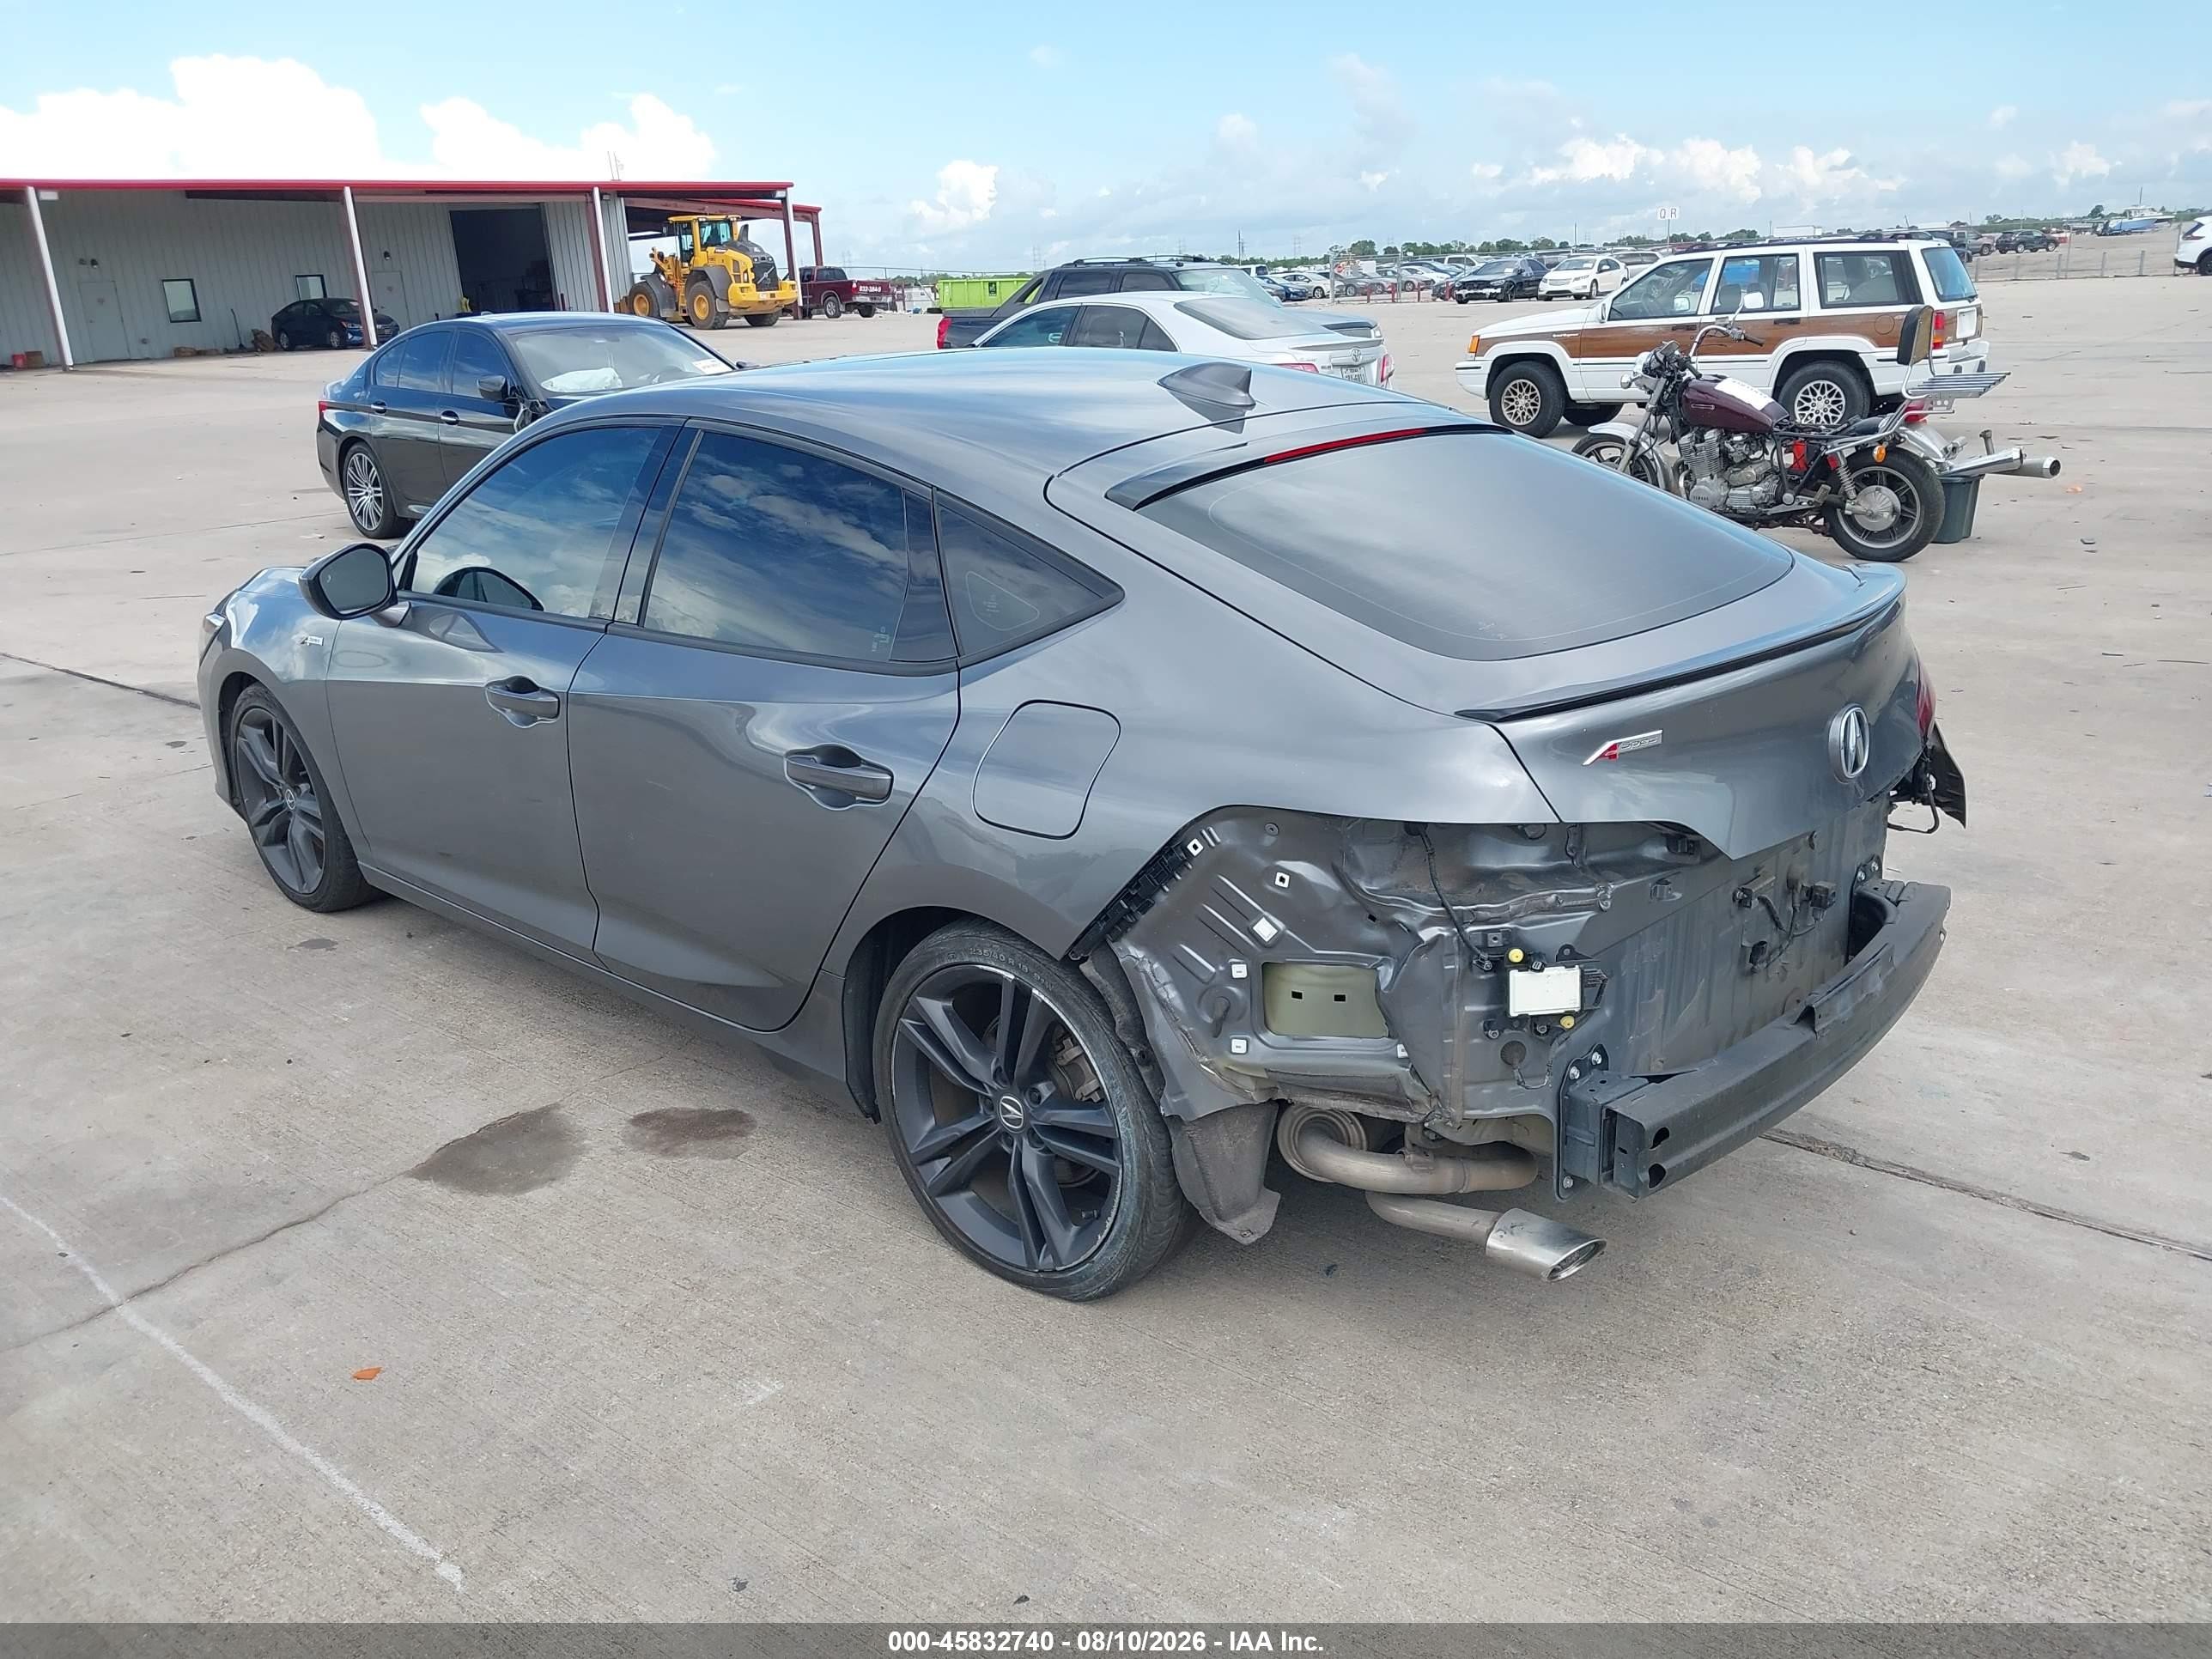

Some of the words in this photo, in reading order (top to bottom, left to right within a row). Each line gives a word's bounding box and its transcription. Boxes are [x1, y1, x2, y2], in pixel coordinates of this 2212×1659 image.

[1670, 208, 1677, 218] R
[969, 947, 1006, 962] 235/40
[1008, 957, 1015, 966] R
[1018, 963, 1029, 973] 18
